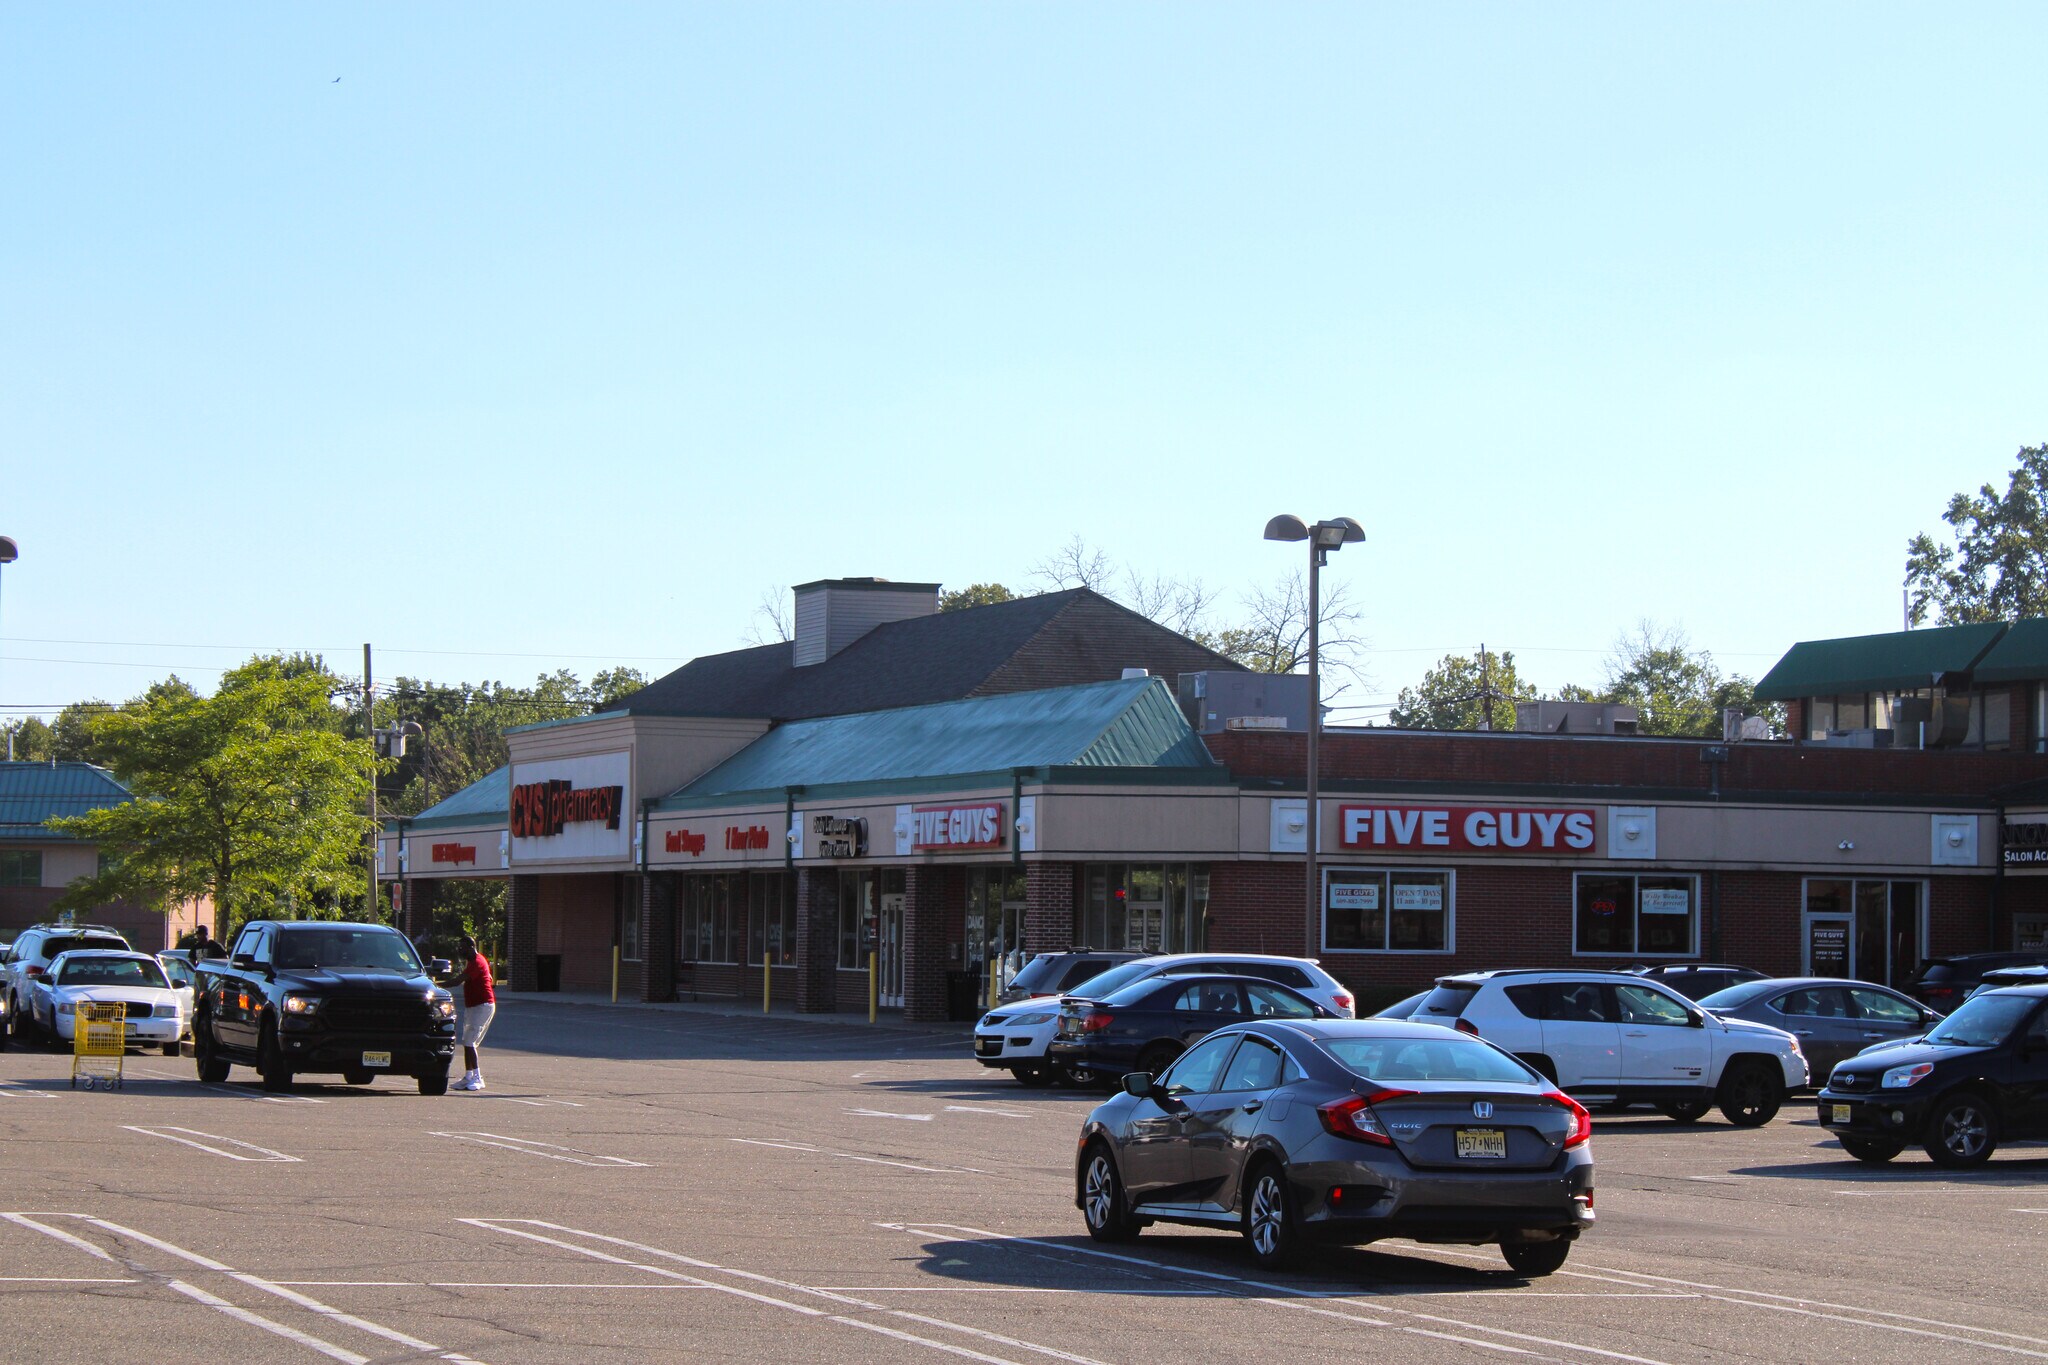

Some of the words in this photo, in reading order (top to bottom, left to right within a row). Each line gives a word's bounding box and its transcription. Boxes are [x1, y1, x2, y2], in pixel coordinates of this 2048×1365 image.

[912, 811, 948, 845] FIVE
[948, 807, 998, 844] GUYS
[1344, 809, 1450, 846] FIVE
[1463, 811, 1594, 849] GUYS
[2004, 851, 2033, 862] SALON
[1395, 889, 1415, 897] OPEN
[1422, 889, 1441, 897] DAYS
